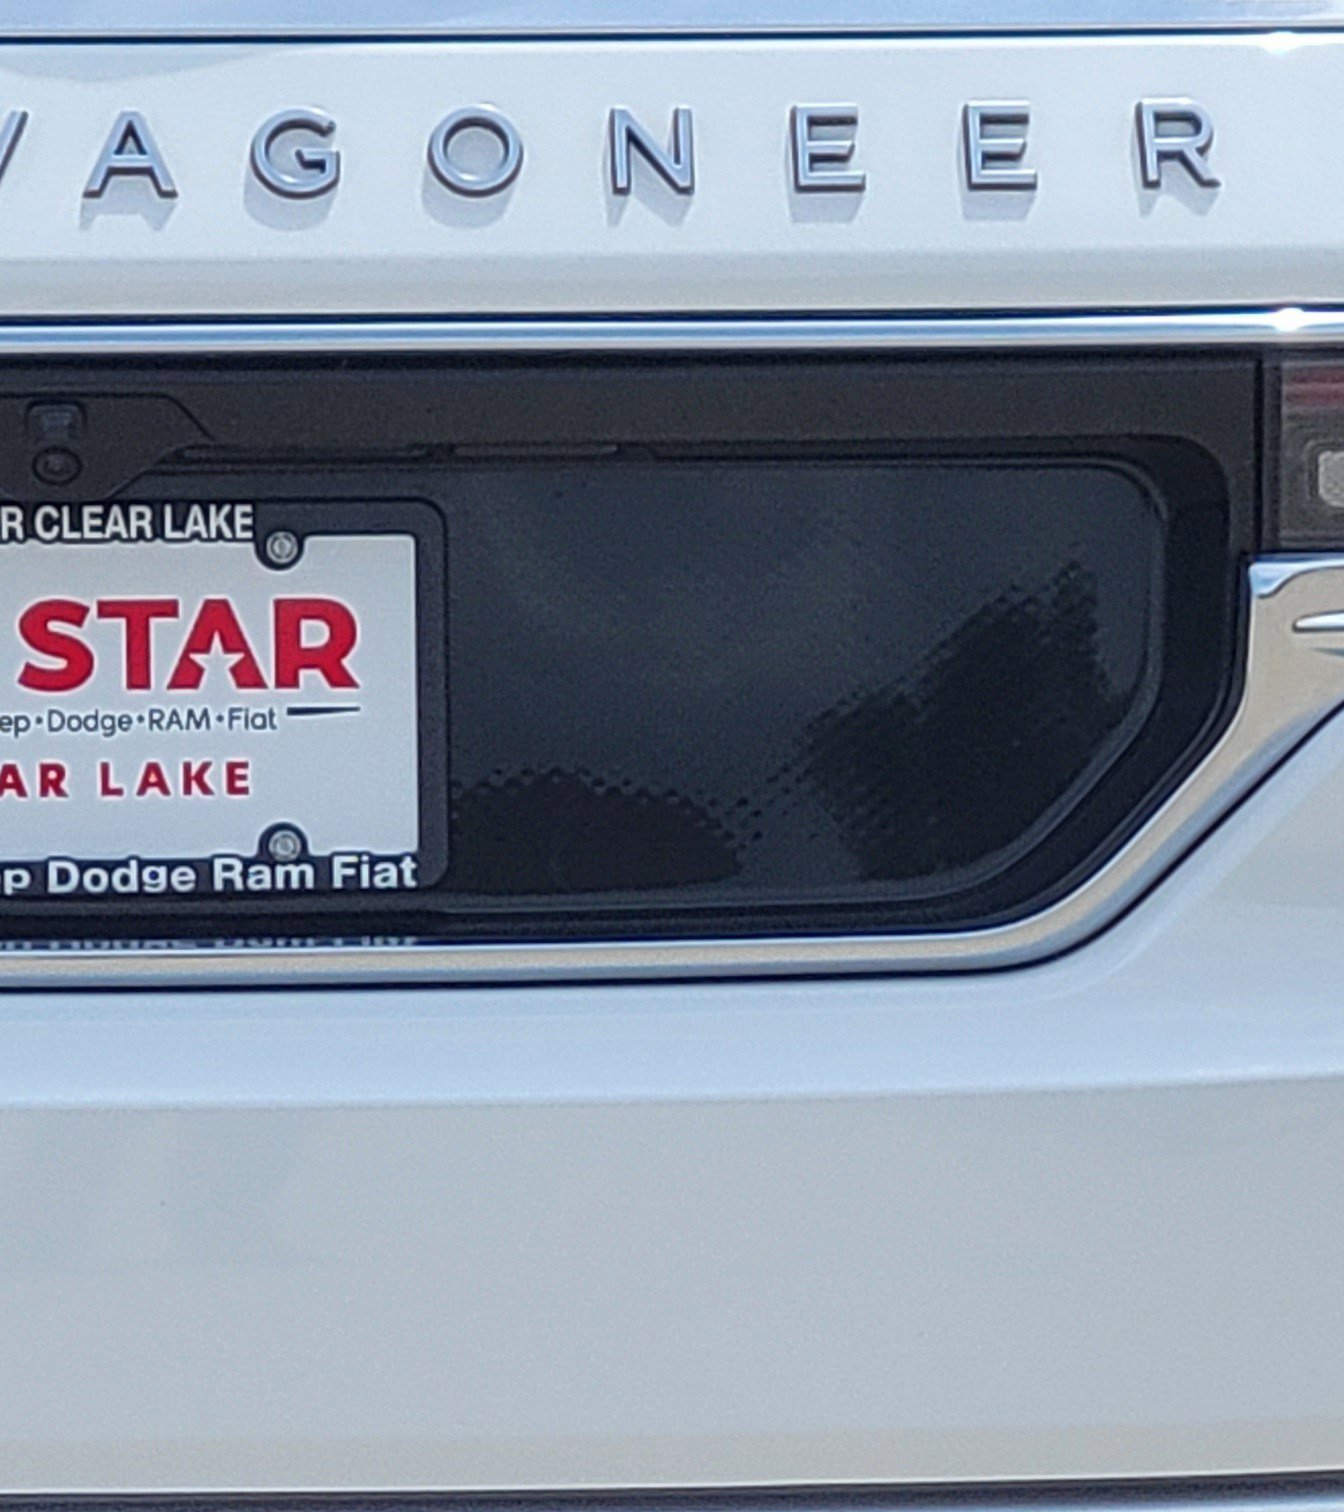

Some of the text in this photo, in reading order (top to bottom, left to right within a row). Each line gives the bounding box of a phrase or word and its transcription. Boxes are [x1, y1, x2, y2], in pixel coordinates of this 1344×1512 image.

[34, 504, 154, 541] CLEAR
[164, 504, 254, 540] LAKE
[17, 597, 360, 692] STAR
[99, 761, 251, 798] LAKE
[47, 857, 197, 893] Dodge
[212, 856, 316, 891] Ram
[331, 853, 418, 889] Fiat
